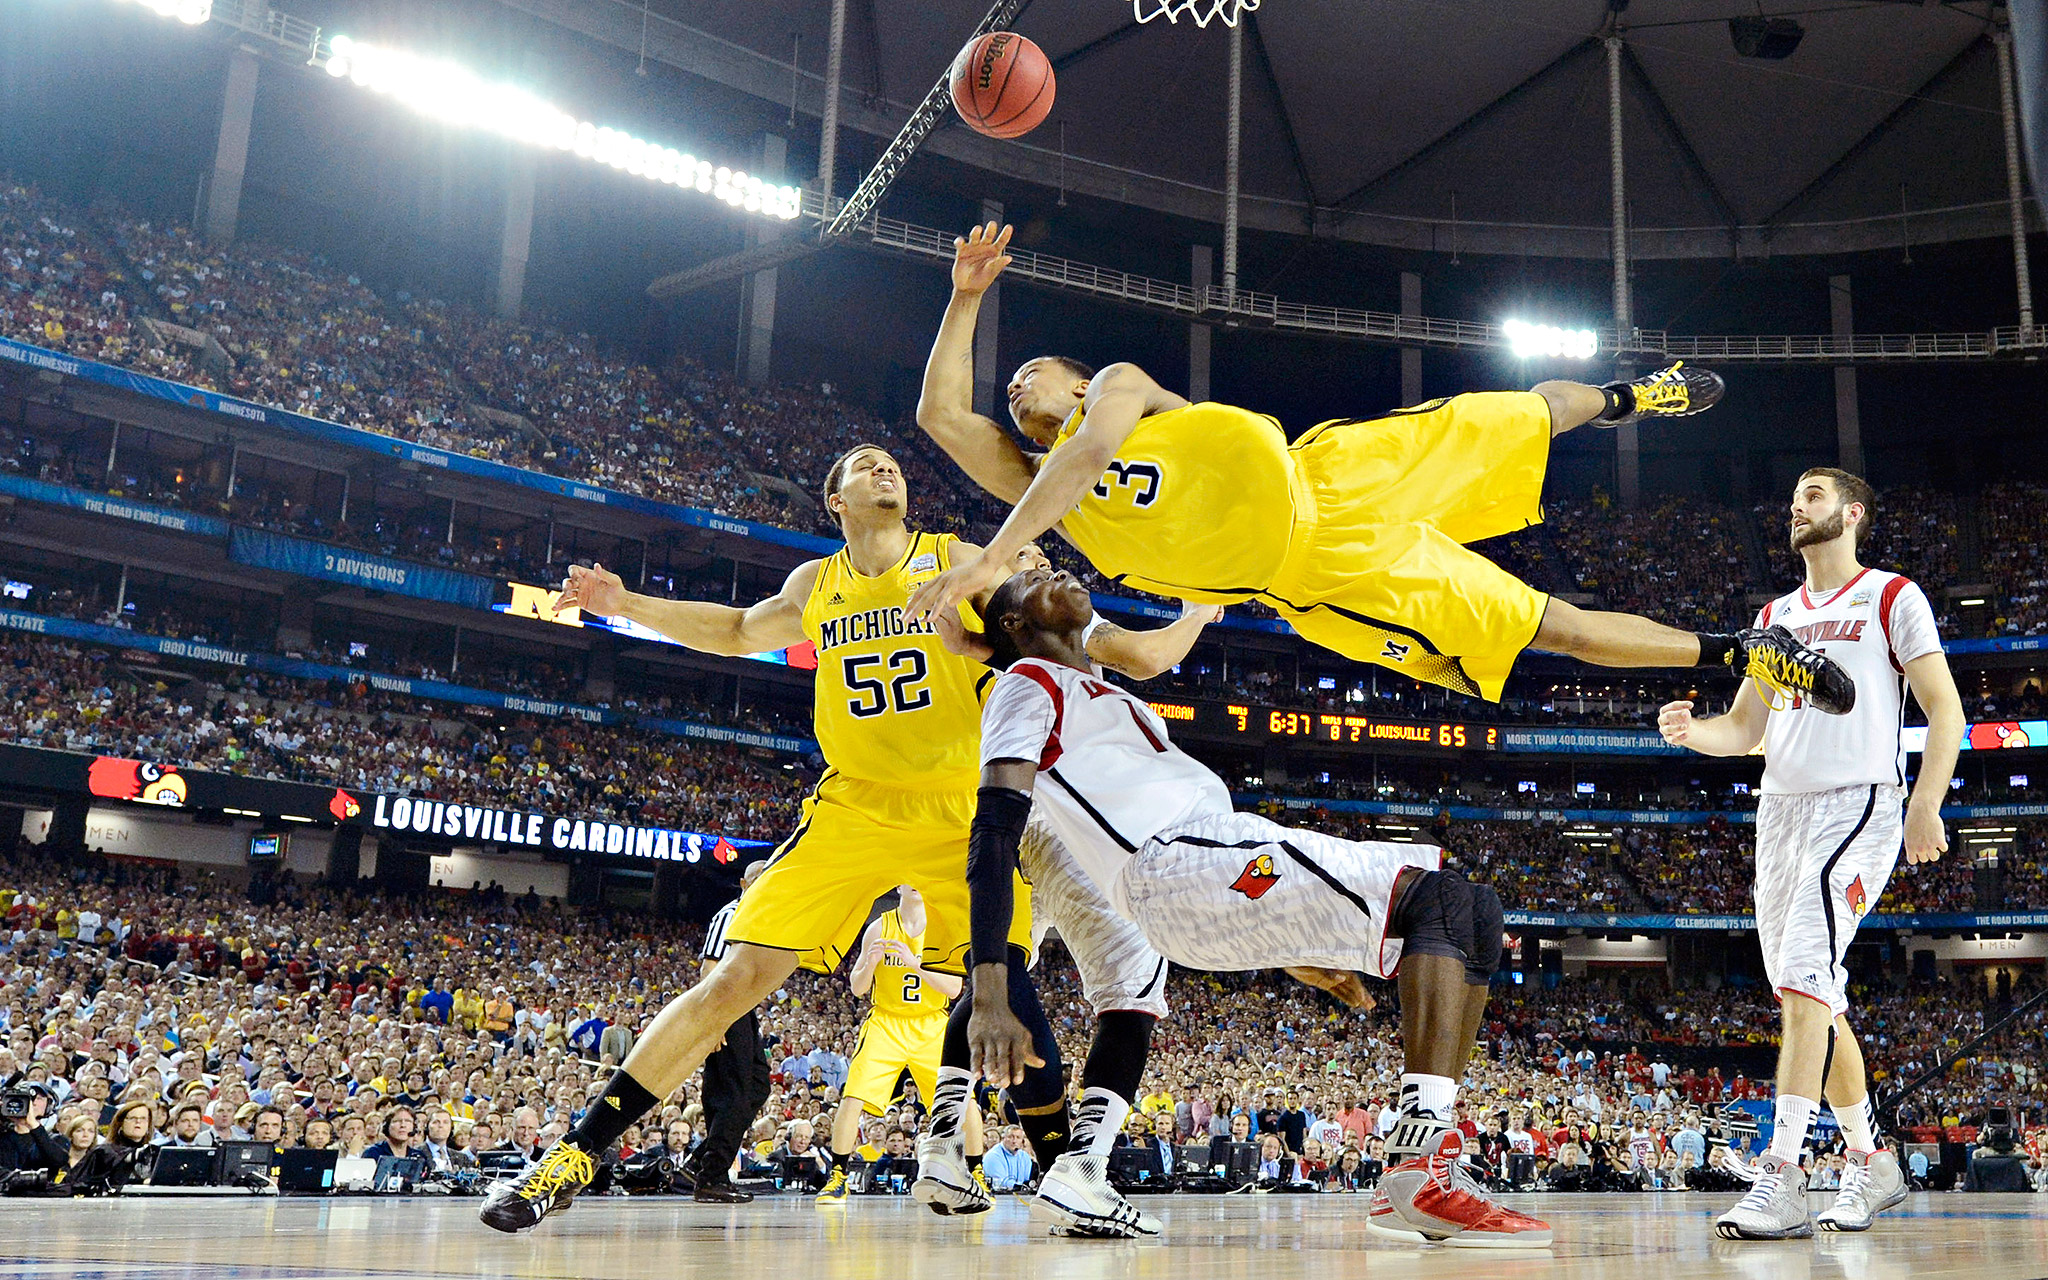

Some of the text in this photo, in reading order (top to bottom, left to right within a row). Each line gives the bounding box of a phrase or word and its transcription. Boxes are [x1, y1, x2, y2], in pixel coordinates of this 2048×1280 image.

[979, 34, 1013, 89] Wilson
[29, 351, 79, 376] TENNESSEE
[218, 401, 266, 422] MINNESOTA
[411, 449, 448, 467] MISSOURI
[1092, 458, 1163, 509] 3
[573, 487, 606, 503] MONTANA
[85, 499, 186, 530] THE ROAD ENDS HERE
[709, 519, 749, 536] NEW MEXICO
[325, 555, 406, 585] 3 DIVISIONS
[9, 614, 46, 633] STATE
[187, 644, 248, 666] LOUISVILLE
[1380, 639, 1411, 663] M
[371, 676, 411, 694] INDIANA
[841, 646, 933, 719] 52
[504, 697, 526, 711] 1982
[527, 700, 558, 716] NORTH
[1237, 716, 1247, 731] 3
[1269, 711, 1311, 735] 6:37
[685, 725, 800, 752] 1983 NORTH CAROLINA STATE
[1330, 724, 1361, 742] 8 2
[1368, 723, 1466, 747] LOUISVILLE 65
[1486, 728, 1497, 744] 2
[1506, 734, 1532, 745] MORE
[1533, 734, 1558, 746] THAN
[1404, 806, 1434, 816] KANSAS
[1650, 813, 1668, 822] UNLV
[1990, 805, 2018, 816] NORTH
[90, 827, 129, 841] MEN
[373, 795, 703, 864] LOUISVILLE CARDINALS
[1675, 917, 1757, 929] CELEBRATING 75 YEA
[1976, 916, 1991, 925] THE
[1991, 916, 2011, 925] ROAD
[2012, 916, 2033, 925] ENDS
[1989, 941, 2016, 949] MEN
[903, 972, 922, 1003] 2
